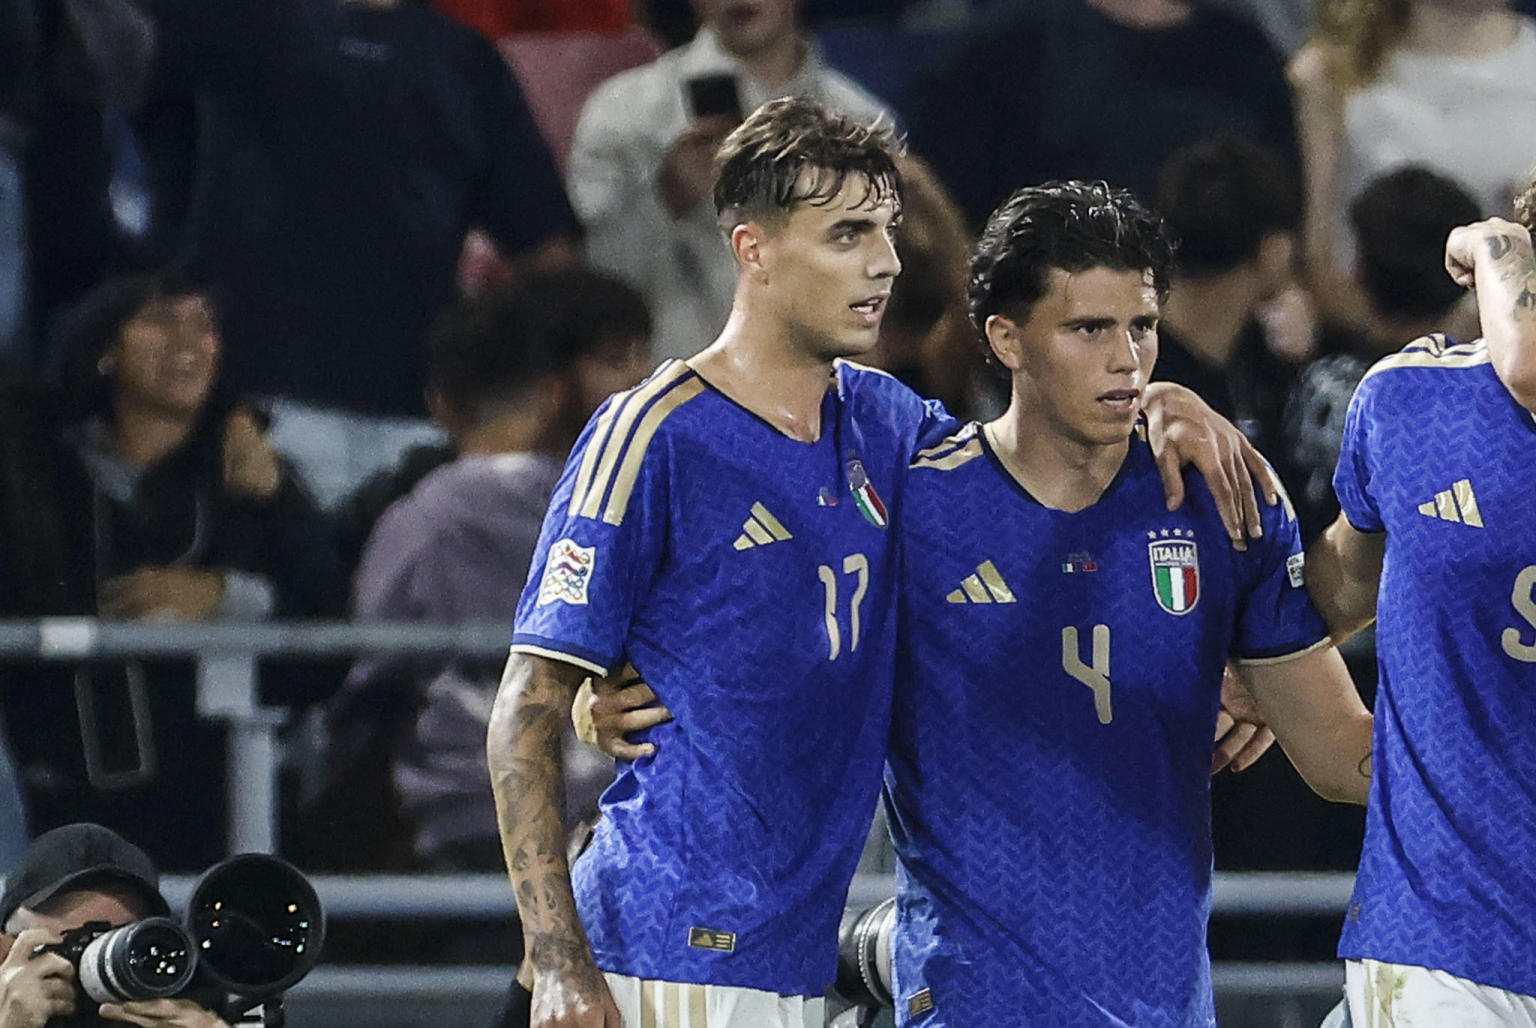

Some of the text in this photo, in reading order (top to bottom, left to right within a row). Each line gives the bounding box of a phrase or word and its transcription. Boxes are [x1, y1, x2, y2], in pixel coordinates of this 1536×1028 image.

[1153, 546, 1194, 563] ITALIA
[818, 553, 868, 660] 17
[1062, 624, 1112, 724] 4
